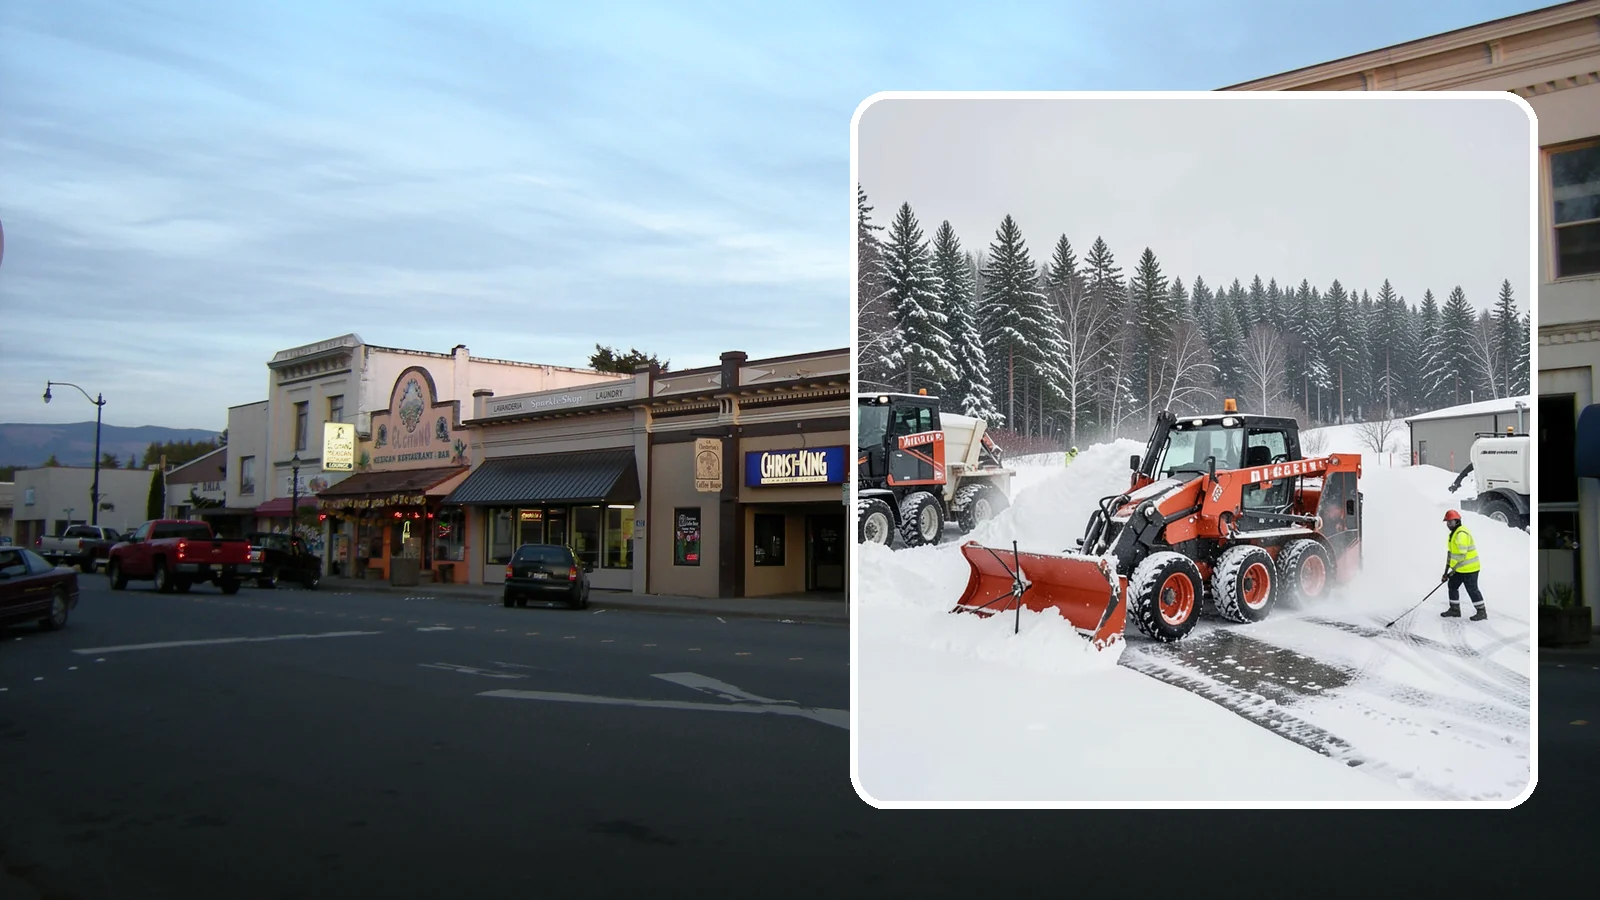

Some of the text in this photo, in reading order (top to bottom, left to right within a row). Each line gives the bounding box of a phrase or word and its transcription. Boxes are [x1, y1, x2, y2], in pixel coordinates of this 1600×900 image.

[595, 389, 624, 400] LAUNDRY
[493, 402, 523, 412] LAVANDERIA
[530, 395, 583, 409] Sparkle Shop
[397, 451, 433, 462] RESTAURANT
[438, 450, 450, 459] BAR
[761, 450, 827, 478] CHRIST KING
